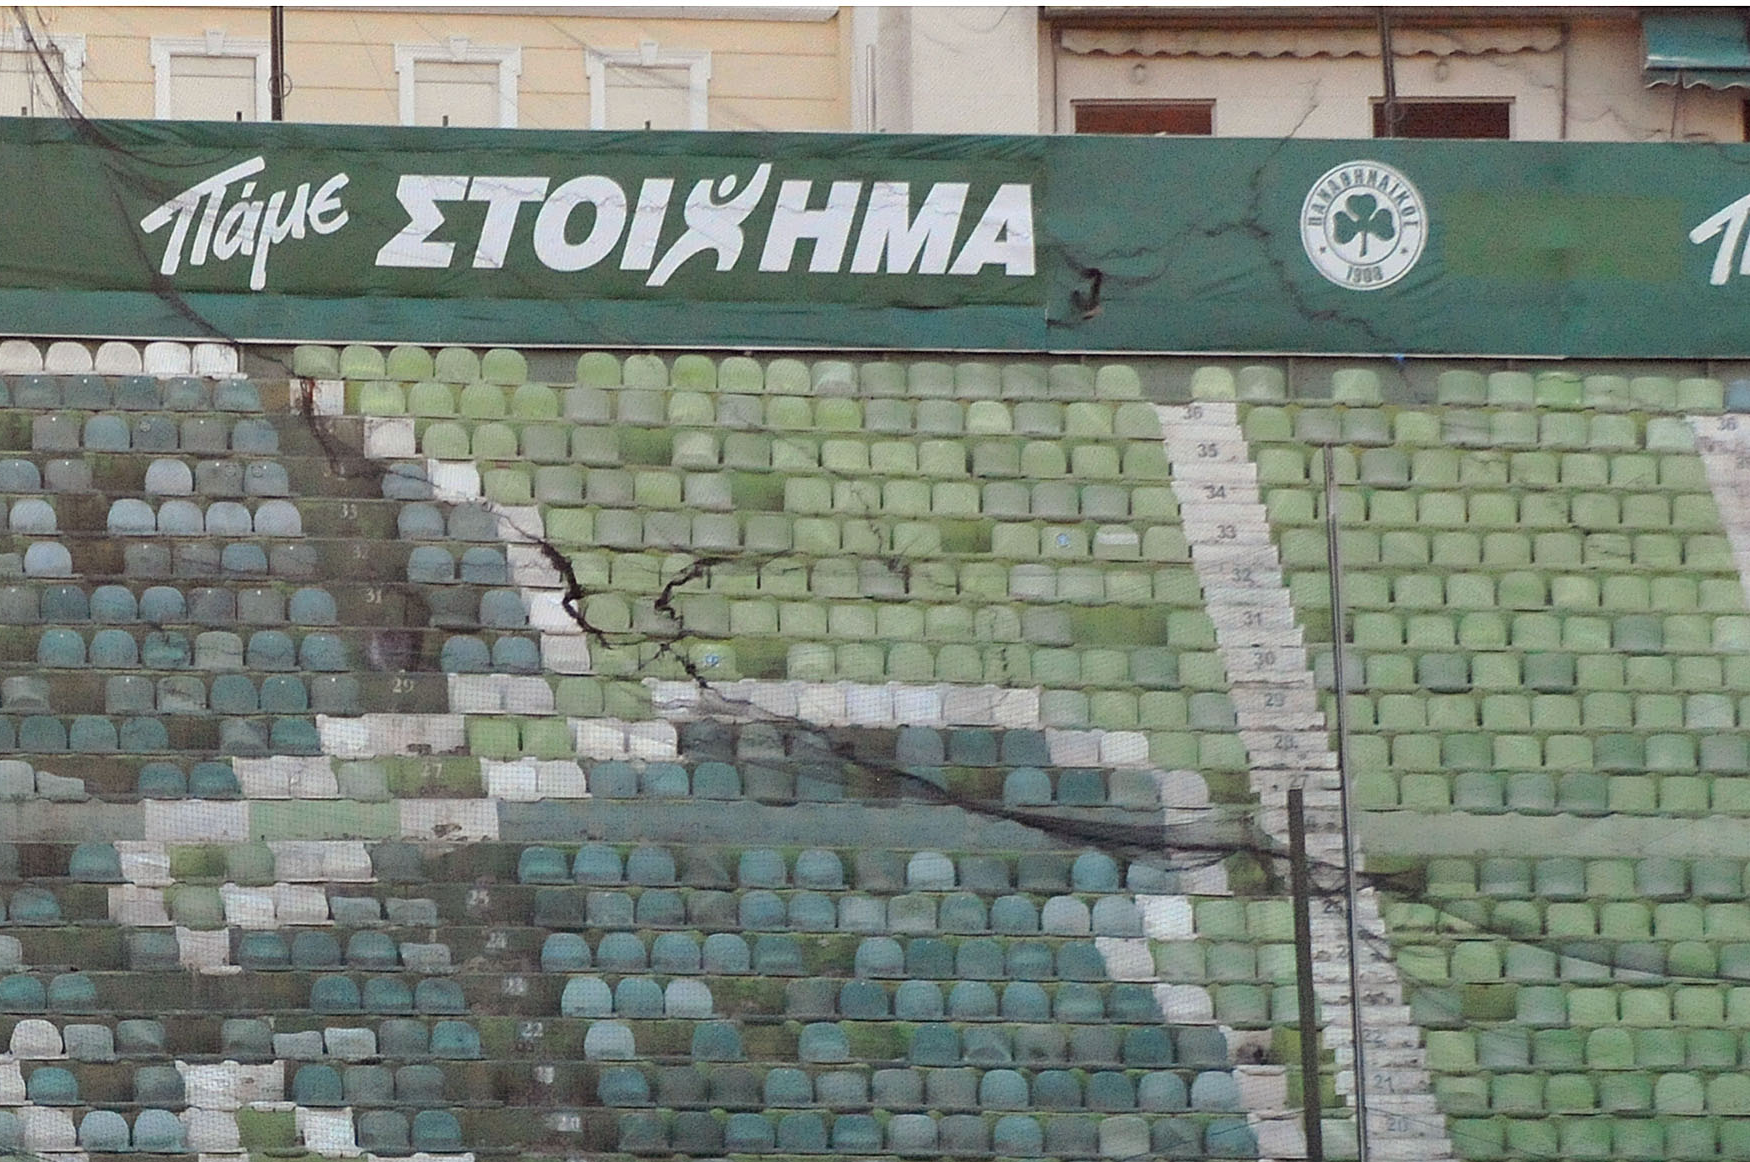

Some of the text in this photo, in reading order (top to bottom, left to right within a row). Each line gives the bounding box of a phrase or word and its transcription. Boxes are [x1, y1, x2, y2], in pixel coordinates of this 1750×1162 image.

[140, 156, 1036, 291] Πάμε ΣΤΟΙΧΗΜΑ
[1346, 265, 1384, 284] 1908
[1198, 443, 1219, 458] 35
[1206, 485, 1227, 500] 34
[1216, 524, 1237, 539] 33
[392, 679, 415, 694] 29
